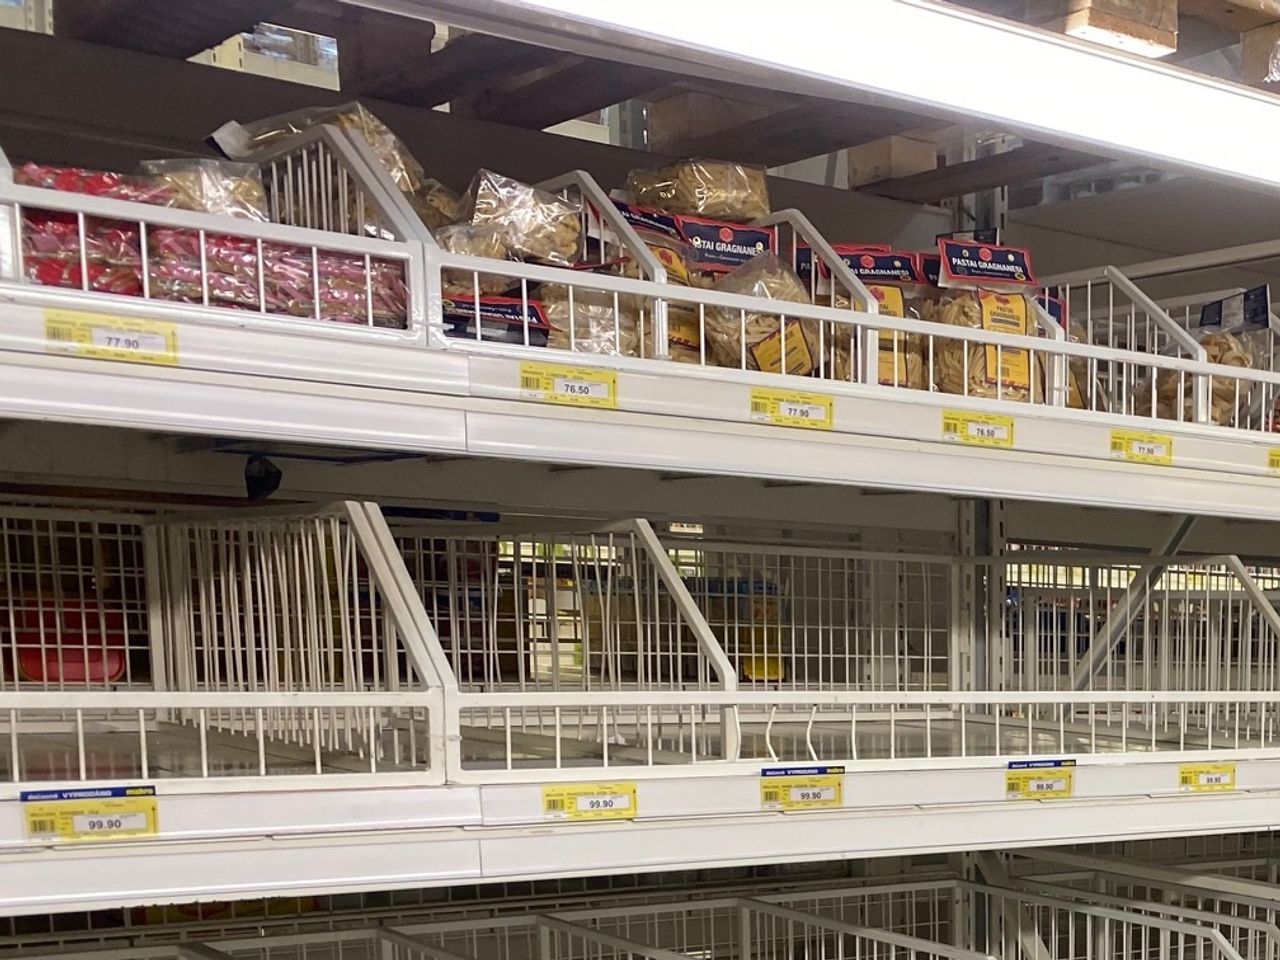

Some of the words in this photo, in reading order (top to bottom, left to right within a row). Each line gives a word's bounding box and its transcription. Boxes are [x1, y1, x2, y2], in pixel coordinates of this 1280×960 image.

[952, 257, 977, 269] PASTAI
[105, 336, 139, 350] 77.90
[564, 383, 590, 395] 76.50
[788, 407, 809, 418] 77.90
[976, 428, 995, 438] 76.50
[800, 792, 822, 800] 99.90
[589, 800, 614, 808] 99.90
[88, 819, 121, 830] 99.90
